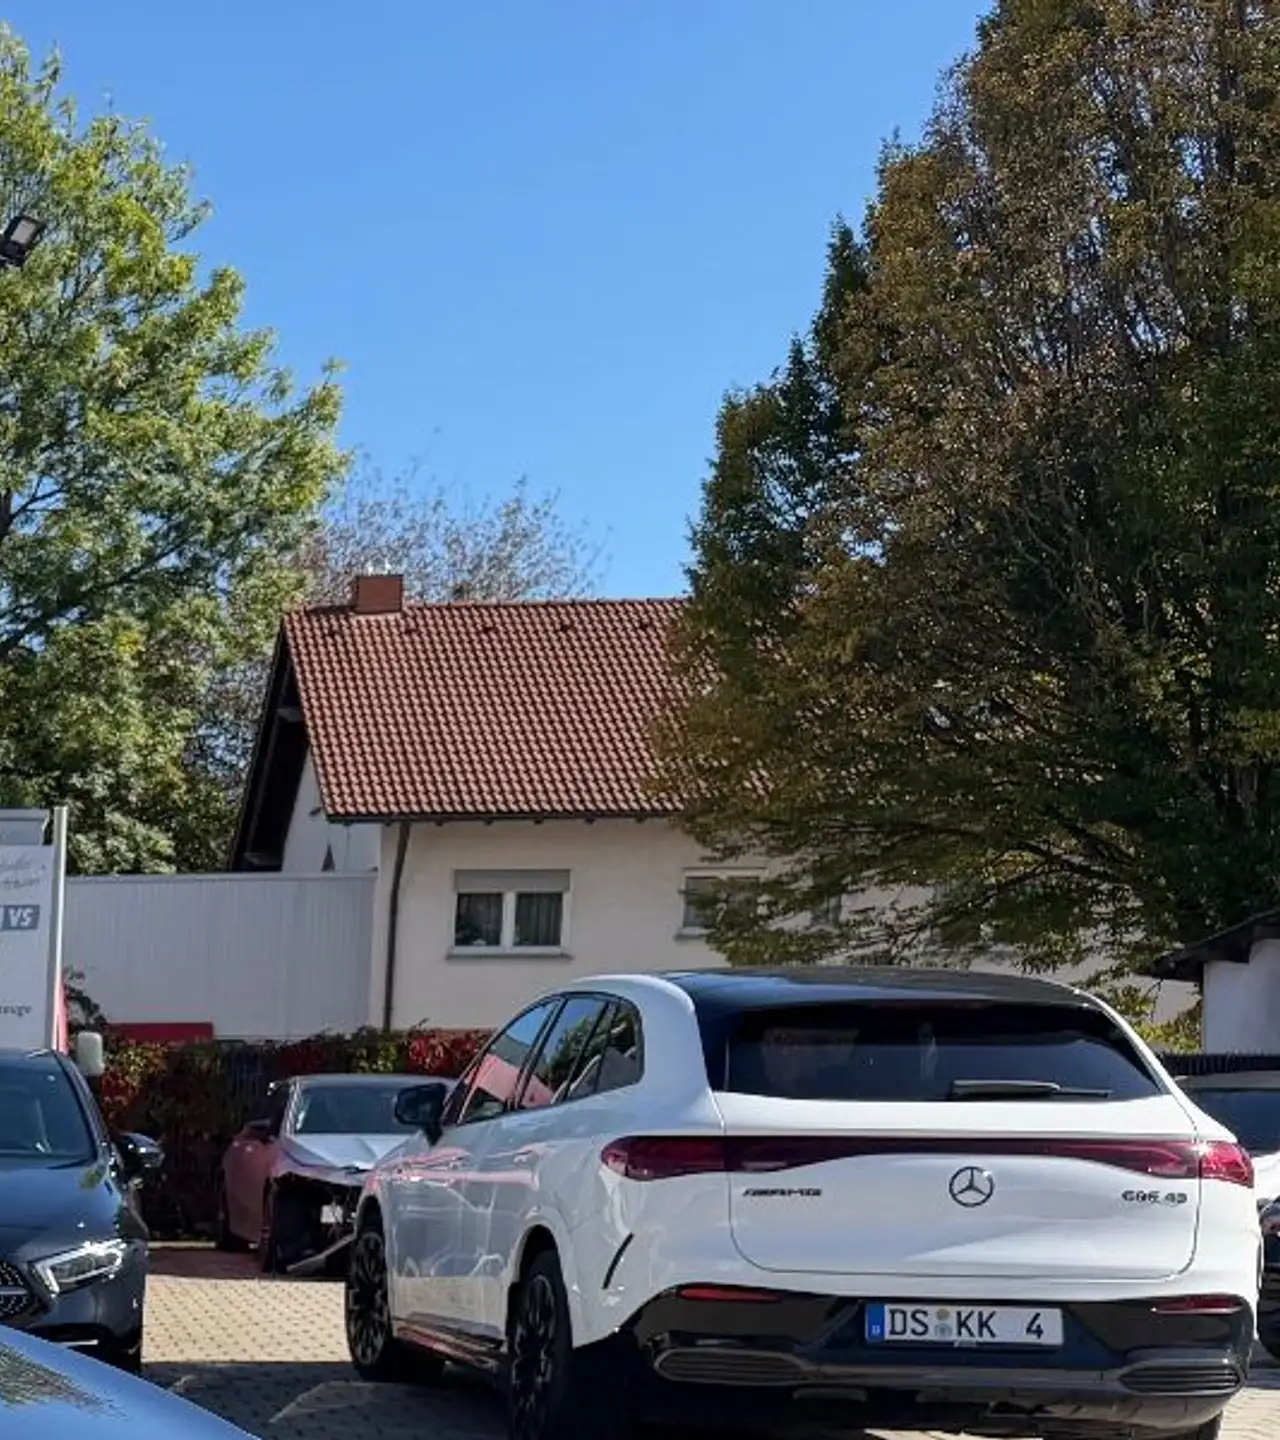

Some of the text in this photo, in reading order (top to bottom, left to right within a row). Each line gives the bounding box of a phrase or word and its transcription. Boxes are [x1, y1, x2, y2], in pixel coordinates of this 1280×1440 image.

[9, 909, 34, 928] VS
[889, 1308, 1044, 1339] DS KK 4
